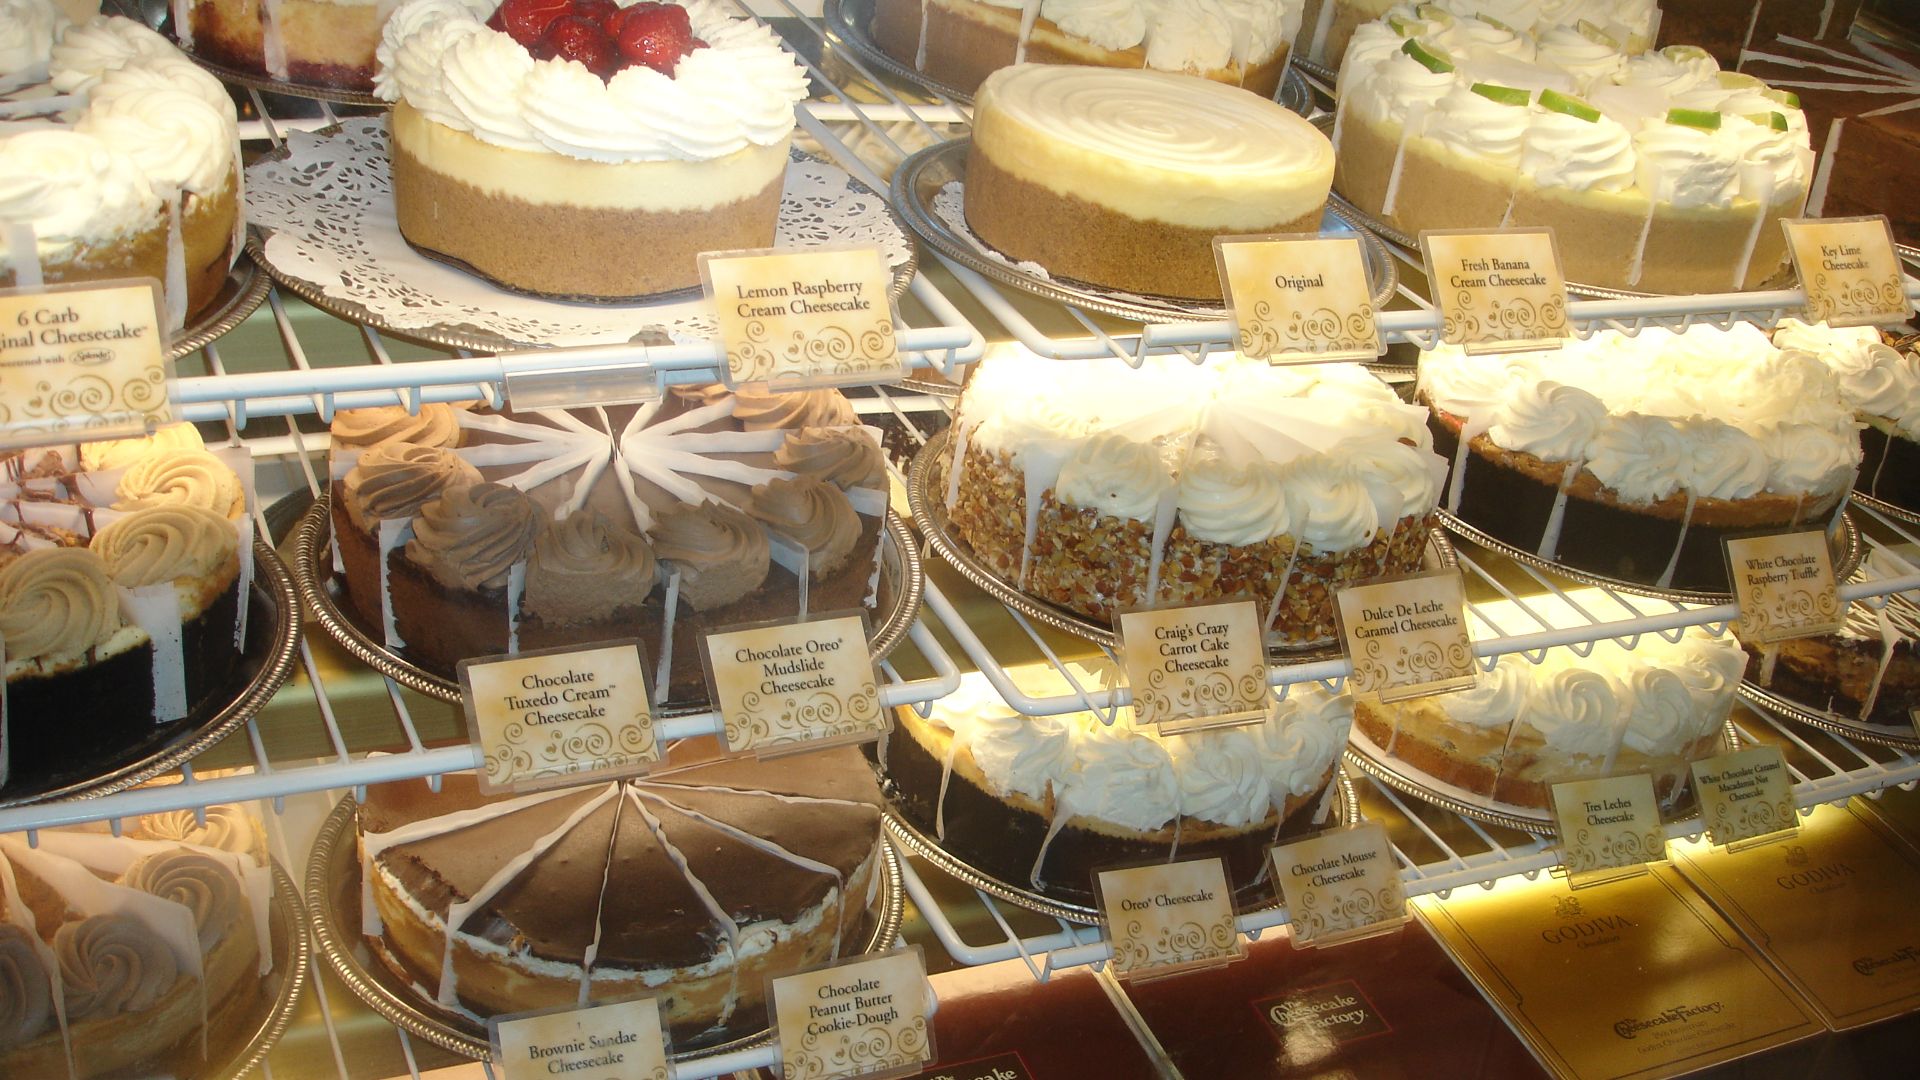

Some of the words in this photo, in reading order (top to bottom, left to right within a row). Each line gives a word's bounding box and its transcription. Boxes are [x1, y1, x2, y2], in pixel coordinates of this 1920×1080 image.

[1821, 245, 1838, 259] Key
[1839, 244, 1862, 256] Lime
[1461, 258, 1489, 271] Fresh
[1492, 258, 1530, 271] Banana
[1823, 258, 1869, 271] Cheesecake
[736, 284, 788, 299] Lemon
[792, 279, 863, 298] Raspberry
[1275, 274, 1324, 292] Original
[1450, 275, 1486, 288] Cream
[1488, 273, 1547, 287] Cheesecake
[17, 310, 29, 326] 6
[34, 307, 80, 325] Carb
[737, 303, 786, 318] Cream
[790, 296, 871, 314] Cheesecake
[1745, 558, 1773, 570] White
[1774, 553, 1816, 568] Chocolate
[1747, 572, 1788, 587] Raspberry
[1789, 567, 1819, 580] Tuffle
[1362, 607, 1394, 622] Dulce
[1395, 604, 1412, 617] De
[1414, 600, 1444, 615] Leche
[1155, 624, 1194, 642] Craig's
[1196, 622, 1229, 637] Crazy
[1355, 621, 1399, 639] Caramel
[1401, 614, 1458, 633] Cheesecake
[735, 644, 802, 663] Chocolate
[1160, 643, 1197, 657] Carrot
[1200, 637, 1230, 652] Cake
[763, 657, 825, 677] Mudslide
[1165, 655, 1229, 673] Cheesecake
[522, 670, 595, 690] Chocolate
[760, 674, 835, 696] Cheesecake
[504, 692, 558, 710] Tuxedo
[524, 704, 606, 726] Cheesecake
[1754, 775, 1768, 785] Nut
[1583, 801, 1602, 813] Tres
[1603, 797, 1632, 811] Leches
[1586, 811, 1635, 826] Cheesecake
[1291, 858, 1341, 877] Chocolate
[1341, 850, 1377, 865] Mousse
[1312, 867, 1366, 887] Cheesecake
[1776, 863, 1856, 890] GODIVA
[1155, 889, 1214, 907] Cheesecake
[1542, 914, 1633, 944] GODIVA
[818, 978, 880, 999] Chocolate
[809, 1002, 852, 1019] Peanut
[855, 994, 894, 1010] Butter
[1270, 995, 1358, 1027] Cheesecake
[807, 1006, 899, 1036] Cookie-Dough
[1614, 1012, 1679, 1040] Cheesecake
[528, 1038, 586, 1060] Brownie
[589, 1030, 638, 1050] Sundae
[547, 1050, 624, 1074] Cheesecake
